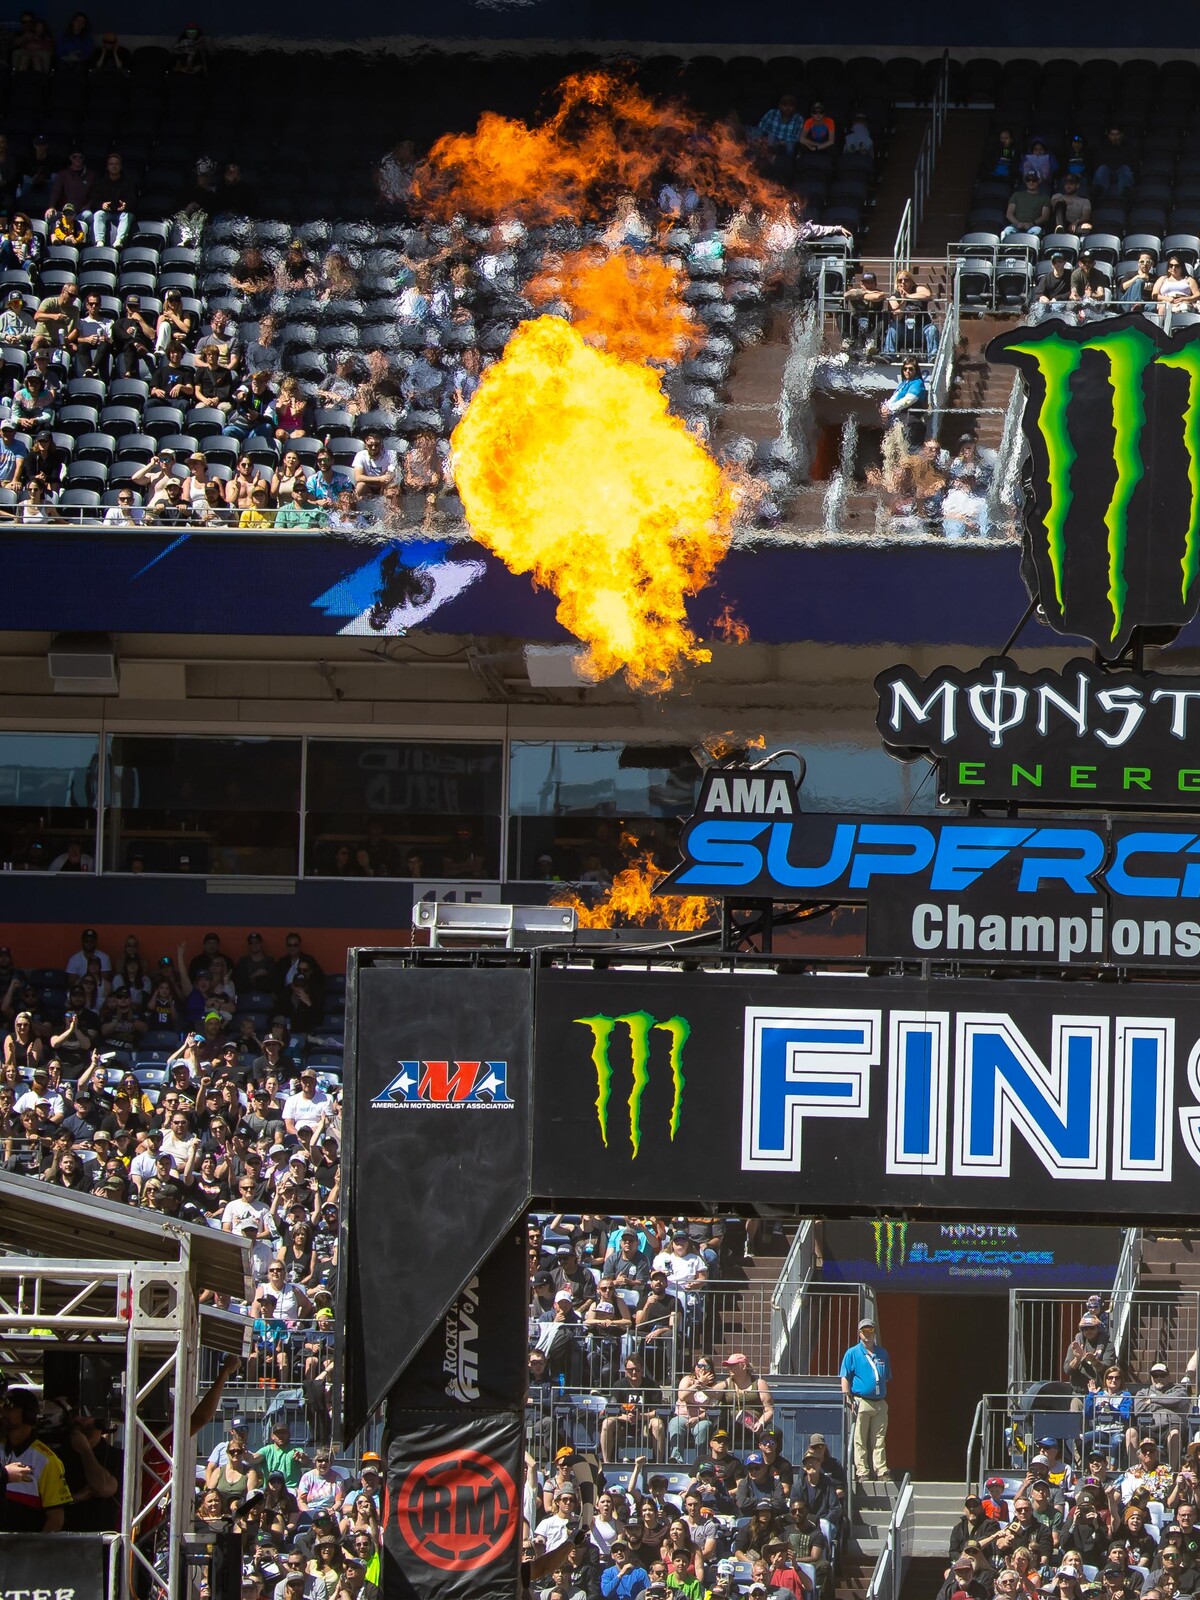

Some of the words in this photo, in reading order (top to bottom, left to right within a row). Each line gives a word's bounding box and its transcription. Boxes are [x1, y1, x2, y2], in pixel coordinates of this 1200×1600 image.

[704, 777, 793, 815] AMA
[370, 1060, 516, 1103] AMA
[410, 1102, 465, 1110] MOTORCYCLIST
[940, 1223, 1018, 1239] MONSTER
[908, 1250, 1056, 1265] SUPERCROSS
[443, 1316, 458, 1376] ROCKY
[419, 1484, 496, 1535] RM
